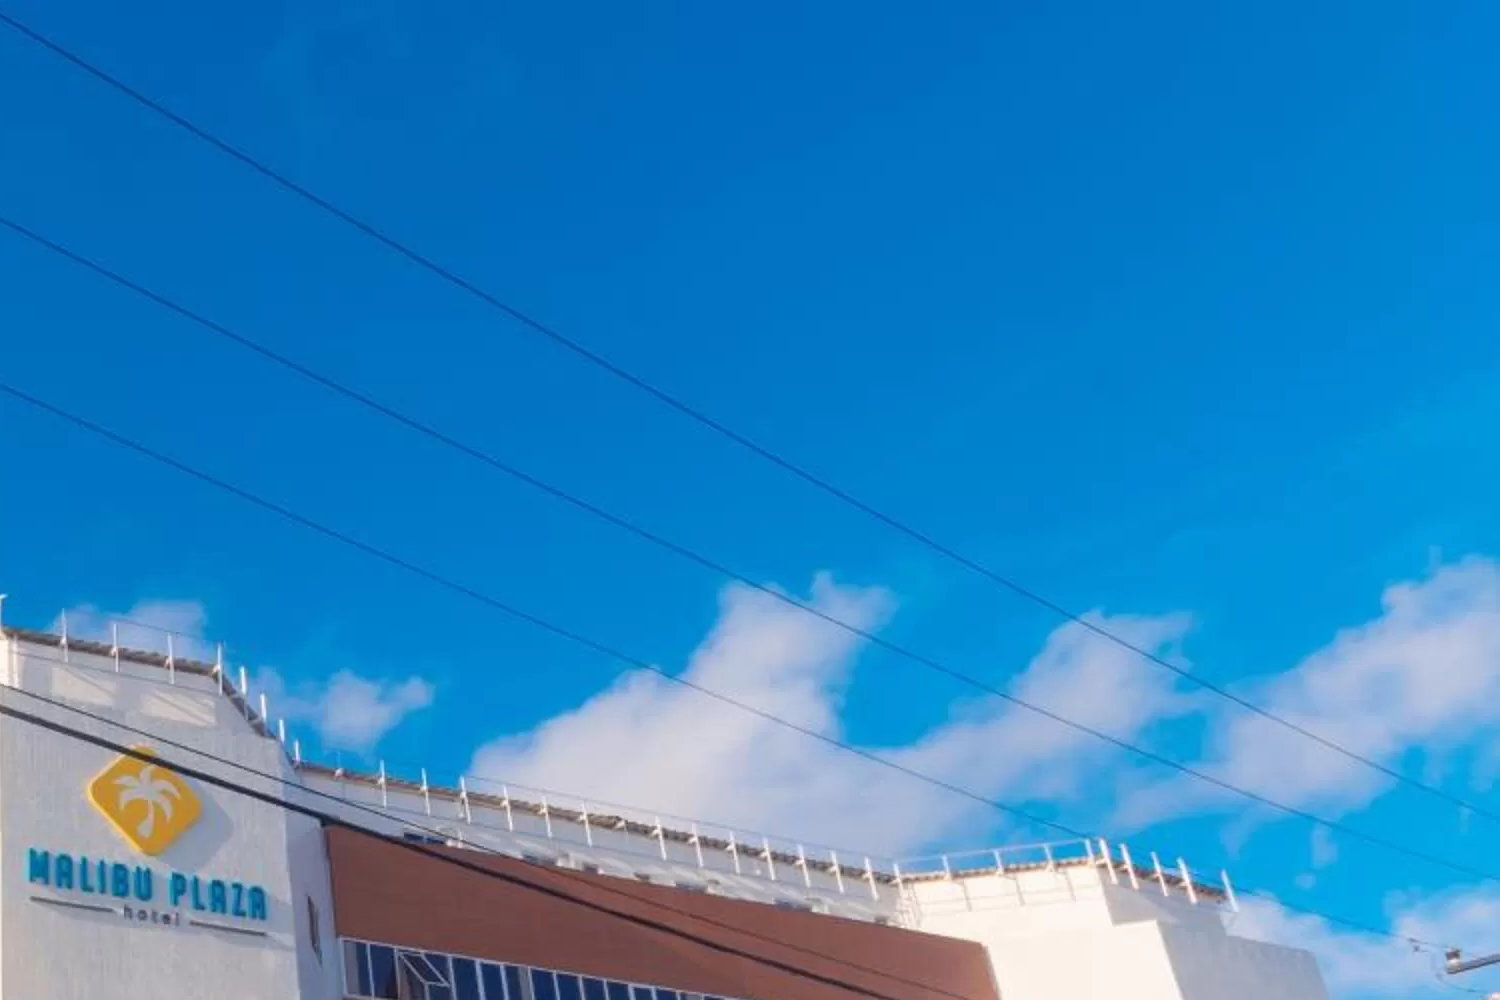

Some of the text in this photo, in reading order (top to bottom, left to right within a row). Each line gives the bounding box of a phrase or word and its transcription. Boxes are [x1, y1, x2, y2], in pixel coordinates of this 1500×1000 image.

[27, 848, 268, 921] MALIBU PLAZA
[123, 903, 180, 927] hotel
